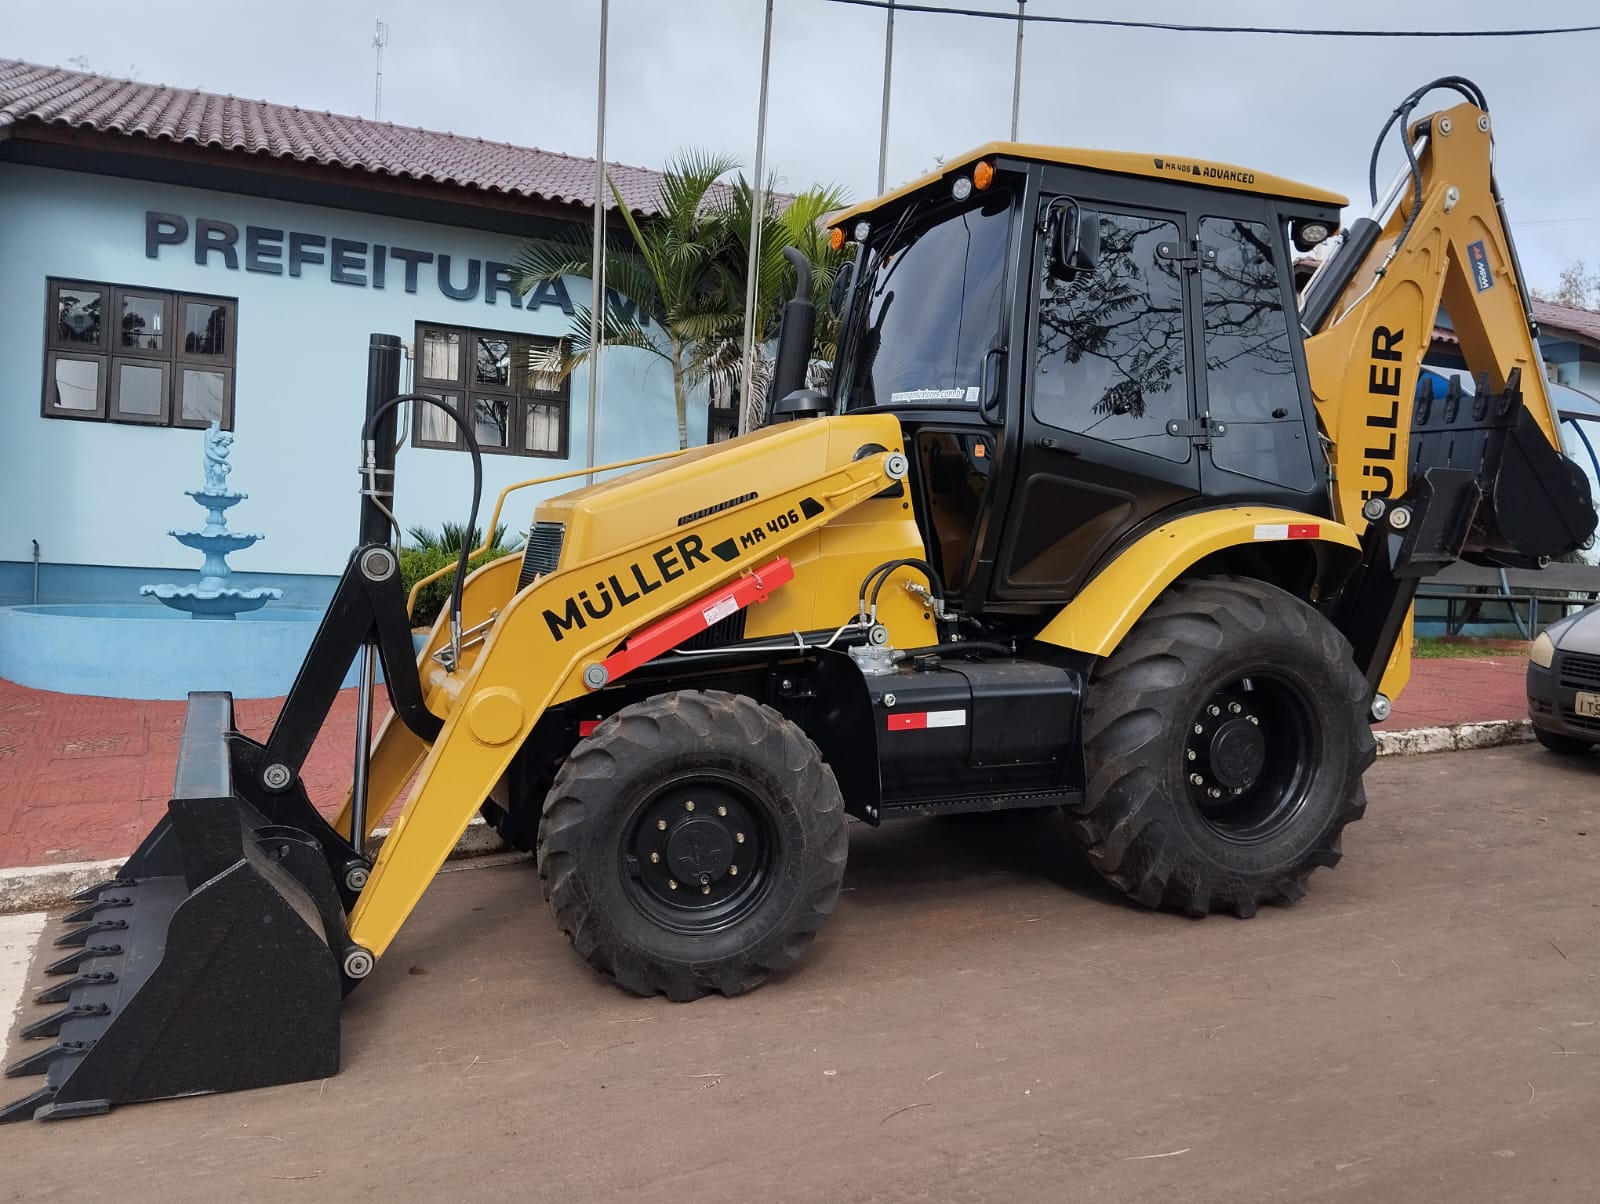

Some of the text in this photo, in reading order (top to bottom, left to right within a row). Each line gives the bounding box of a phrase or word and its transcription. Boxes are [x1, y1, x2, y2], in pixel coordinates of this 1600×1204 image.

[1203, 166, 1255, 184] ADVANCED
[145, 210, 575, 315] PREFEITURA
[1361, 325, 1405, 501] ÜLLER
[541, 534, 711, 642] MÜLLER
[739, 527, 767, 550] MR
[766, 509, 800, 533] 406
